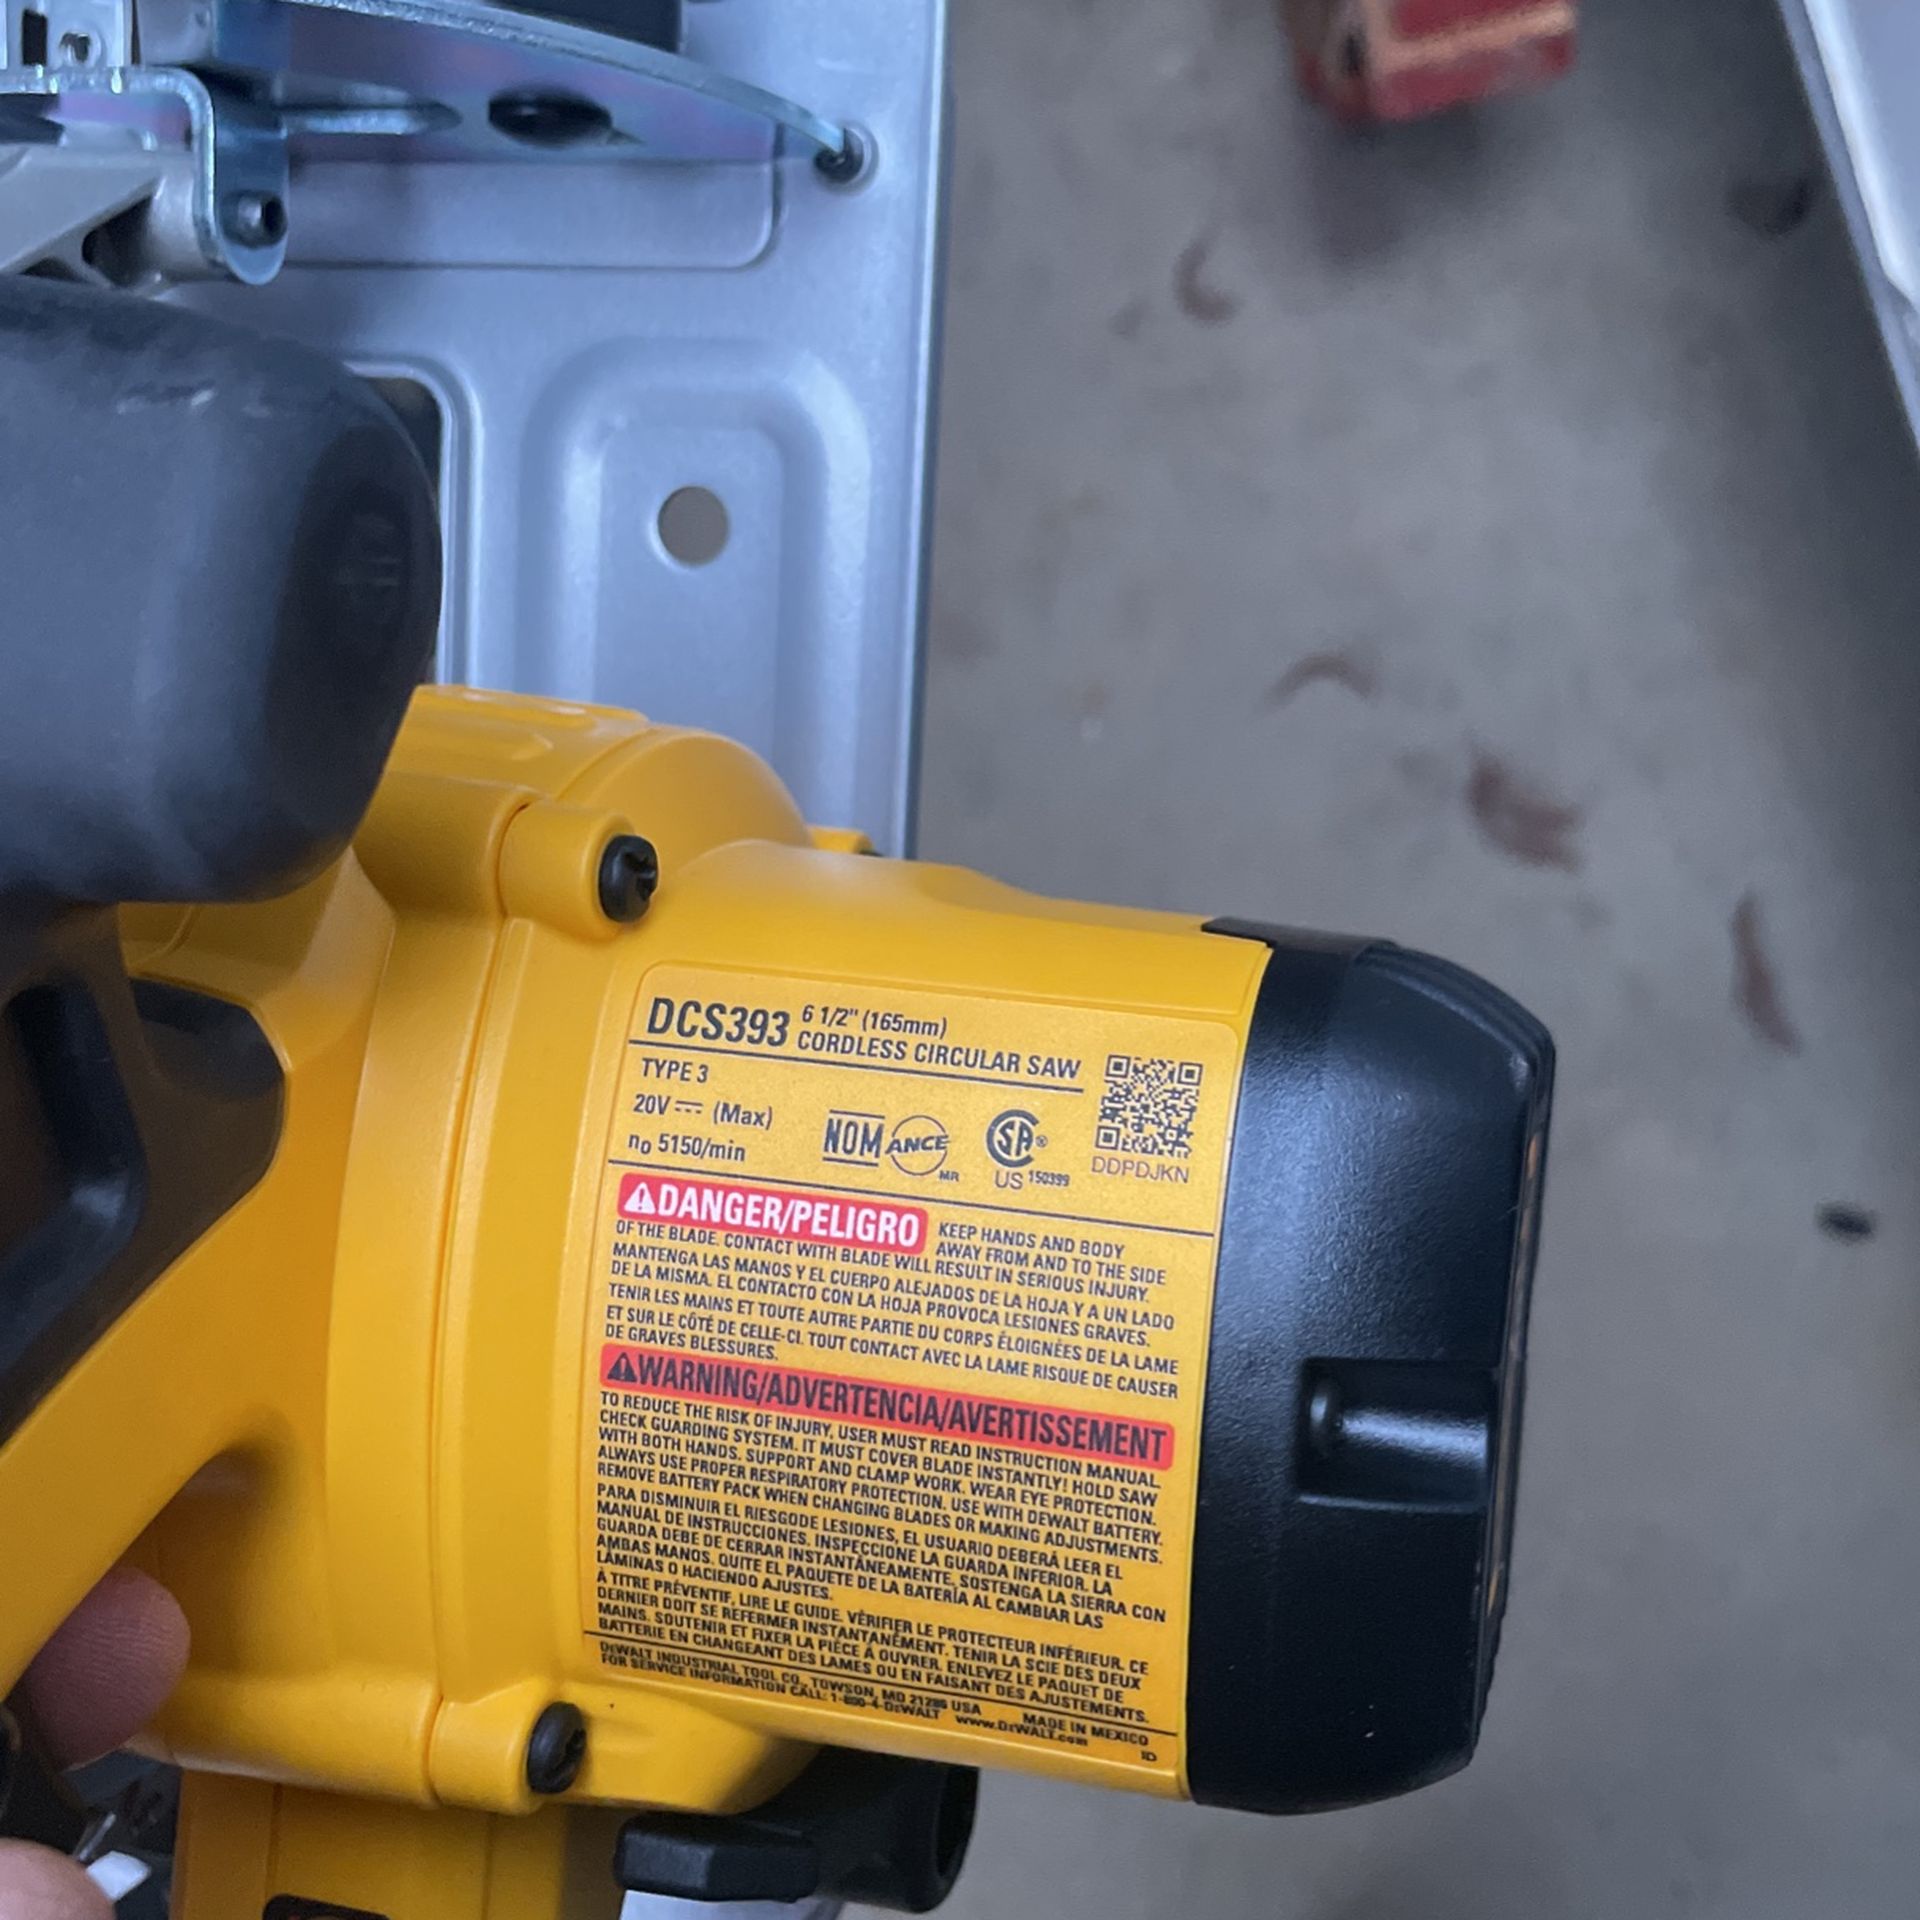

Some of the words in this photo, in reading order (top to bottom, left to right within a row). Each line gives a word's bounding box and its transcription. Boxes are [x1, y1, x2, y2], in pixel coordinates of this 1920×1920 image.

[647, 996, 791, 1048] DCS393
[802, 1004, 815, 1024] 6
[820, 1006, 859, 1028] 1/2"
[862, 1009, 947, 1039] (165mm)
[643, 1057, 694, 1082] TYPE
[696, 1064, 709, 1084] 3
[797, 1030, 909, 1061] CORDLESS
[914, 1042, 1021, 1074] CIRCULAR
[1026, 1055, 1082, 1079] SAW
[633, 1093, 672, 1116] 20V
[713, 1101, 773, 1131] (Max)
[658, 1133, 746, 1162] 5150/min
[824, 1118, 885, 1159] NOM
[939, 1170, 960, 1182] MR
[995, 1172, 1023, 1189] US
[1028, 1169, 1070, 1187] 150399
[1091, 1156, 1190, 1184] DDPDJKN
[658, 1184, 919, 1248] DANGER/PELIGRO
[616, 1217, 638, 1235] OF
[636, 1219, 668, 1240] THE
[666, 1222, 722, 1247] BLADE.
[721, 1229, 795, 1256] CONTACT
[794, 1238, 840, 1261] WITH
[839, 1244, 893, 1268] BLADE
[892, 1251, 931, 1274] WILL
[930, 1259, 993, 1282] RESULT
[994, 1267, 1014, 1284] IN
[1016, 1270, 1085, 1294] SERIOUS
[1088, 1279, 1149, 1303] INJURY.
[935, 1241, 983, 1260] AWAY
[985, 1246, 1030, 1267] FROM
[1032, 1253, 1068, 1272] AND
[1071, 1257, 1092, 1275] TO
[1095, 1260, 1126, 1280] THE
[1129, 1266, 1166, 1285] SIDE
[938, 1222, 978, 1241] KEEP
[980, 1227, 1037, 1249] HANDS
[1039, 1235, 1076, 1254] AND
[1079, 1239, 1125, 1260] BODY
[611, 1259, 631, 1277] DE
[633, 1262, 652, 1280] LA
[655, 1265, 713, 1288] MISMA.
[716, 1273, 734, 1290] EL
[737, 1276, 817, 1301] CONTACTO
[821, 1286, 854, 1306] CON
[857, 1292, 877, 1309] LA
[880, 1294, 922, 1316] HOJA
[926, 1300, 1000, 1326] PROVOCA
[1004, 1311, 1080, 1337] LESIONES
[1084, 1323, 1151, 1348] GRAVES.
[612, 1242, 699, 1267] MANTENGA
[702, 1252, 731, 1271] LAS
[734, 1256, 792, 1279] MANOS
[796, 1264, 806, 1281] Y
[808, 1266, 826, 1283] EL
[830, 1269, 891, 1292] CUERPO
[892, 1277, 976, 1303] ALEJADOS
[979, 1288, 1000, 1307] DE
[1003, 1291, 1023, 1310] LA
[1026, 1294, 1070, 1316] HOJA
[1074, 1301, 1085, 1318] Y
[1086, 1304, 1100, 1320] A
[1103, 1305, 1128, 1324] UN
[1132, 1310, 1175, 1331] LADO
[605, 1323, 625, 1340] DE
[628, 1326, 687, 1348] GRAVES
[690, 1334, 779, 1361] BLESSURES.
[610, 1282, 651, 1303] TENIR
[654, 1288, 681, 1306] LES
[683, 1292, 734, 1313] MAINS
[736, 1299, 756, 1316] ET
[757, 1301, 806, 1323] TOUTE
[807, 1309, 857, 1330] AUTRE
[860, 1315, 915, 1338] PARTIE
[917, 1323, 940, 1341] DU
[943, 1326, 994, 1349] CORPS
[1086, 1347, 1107, 1365] DE
[1110, 1350, 1131, 1369] LA
[1134, 1354, 1179, 1376] LAME
[639, 1354, 1168, 1462] WARNING/ADVERTENCIA/AVERTISSEMENT
[600, 1408, 648, 1430] CHECK
[650, 1416, 730, 1442] GUARDING
[732, 1428, 799, 1452] SYSTEM.
[802, 1438, 817, 1454] IT
[819, 1440, 866, 1462] MUST
[868, 1447, 919, 1470] COVER
[922, 1456, 974, 1478] BLADE
[977, 1463, 1068, 1494] INSTANTLY!
[1072, 1479, 1115, 1501] HOLD
[1118, 1487, 1158, 1508] SAW
[601, 1390, 620, 1407] TO
[623, 1394, 681, 1417] REDUCE
[684, 1402, 713, 1421] THE
[715, 1407, 750, 1427] RISK
[753, 1412, 773, 1429] OF
[775, 1415, 834, 1440] INJURY,
[838, 1424, 878, 1445] USER
[881, 1431, 928, 1453] MUST
[930, 1439, 972, 1459] READ
[976, 1445, 1083, 1477] INSTRUCTION
[1086, 1462, 1161, 1489] MANUAL.
[597, 1461, 656, 1484] REMOVE
[658, 1470, 721, 1494] BATTERY
[723, 1480, 761, 1500] PACK
[763, 1486, 809, 1507] WHEN
[812, 1493, 890, 1520] CHANGING
[893, 1506, 952, 1530] BLADES
[954, 1515, 976, 1533] OR
[978, 1519, 1041, 1544] MAKING
[1043, 1531, 1163, 1565] ADJUSTMENTS.
[597, 1482, 637, 1503] PARA
[640, 1488, 721, 1516] DISMINUIR
[724, 1501, 741, 1519] EL
[903, 1529, 921, 1547] EL
[924, 1533, 994, 1558] USUARIO
[1063, 1555, 1102, 1577] LEER
[1104, 1563, 1123, 1581] EL
[596, 1499, 662, 1524] MANUAL
[664, 1509, 684, 1527] DE
[814, 1533, 917, 1564] INSPECCIONE
[920, 1550, 941, 1568] LA
[944, 1554, 1010, 1580] GUARDA
[1092, 1578, 1113, 1597] LA
[667, 1561, 679, 1576] O
[682, 1564, 759, 1589] HACIENDO
[598, 1616, 666, 1640] BATTERIE
[668, 1628, 689, 1644] EN
[692, 1632, 785, 1660] CHANGEANT
[787, 1648, 817, 1666] DES
[820, 1654, 872, 1675] LAMES
[875, 1664, 898, 1680] OU
[900, 1667, 922, 1684] EN
[925, 1671, 992, 1694] FAISANT
[995, 1684, 1026, 1701] DES
[1022, 1711, 1067, 1732] MADE
[1070, 1721, 1087, 1736] IN
[1090, 1725, 1149, 1747] MEXICO
